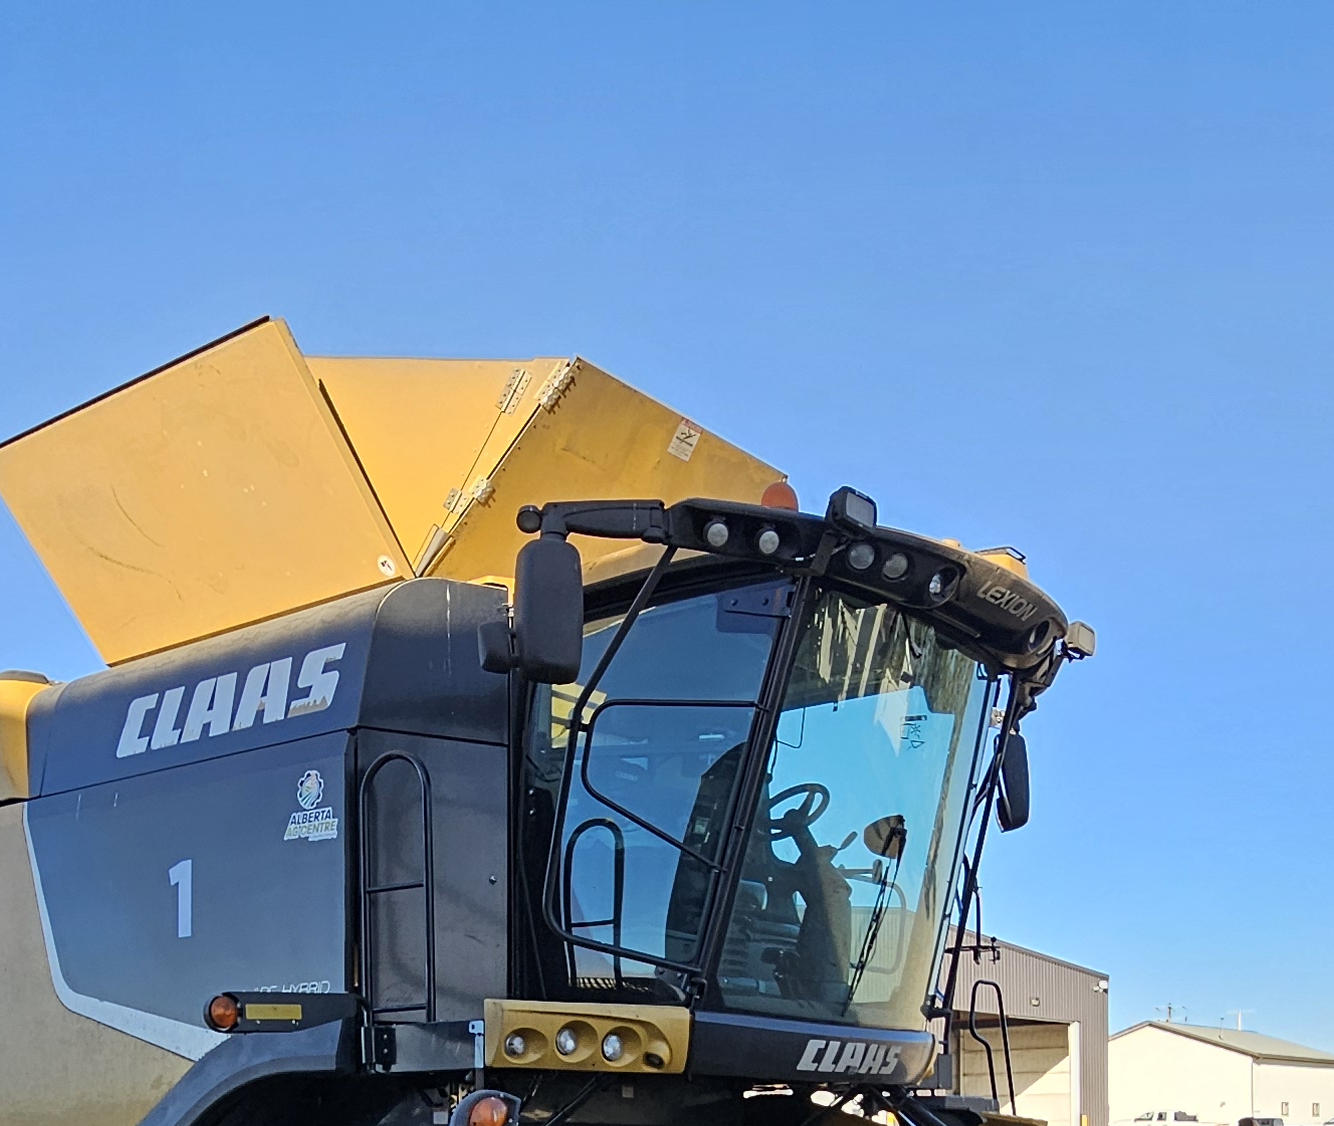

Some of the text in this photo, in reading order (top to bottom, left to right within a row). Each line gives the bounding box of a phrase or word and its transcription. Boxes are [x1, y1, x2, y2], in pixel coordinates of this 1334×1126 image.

[976, 580, 1038, 621] LEXION
[116, 642, 347, 759] CLAAS
[290, 809, 332, 826] ALBERTA
[300, 820, 336, 836] CENTRE
[168, 859, 192, 938] 1
[796, 1039, 903, 1075] CLAAS
